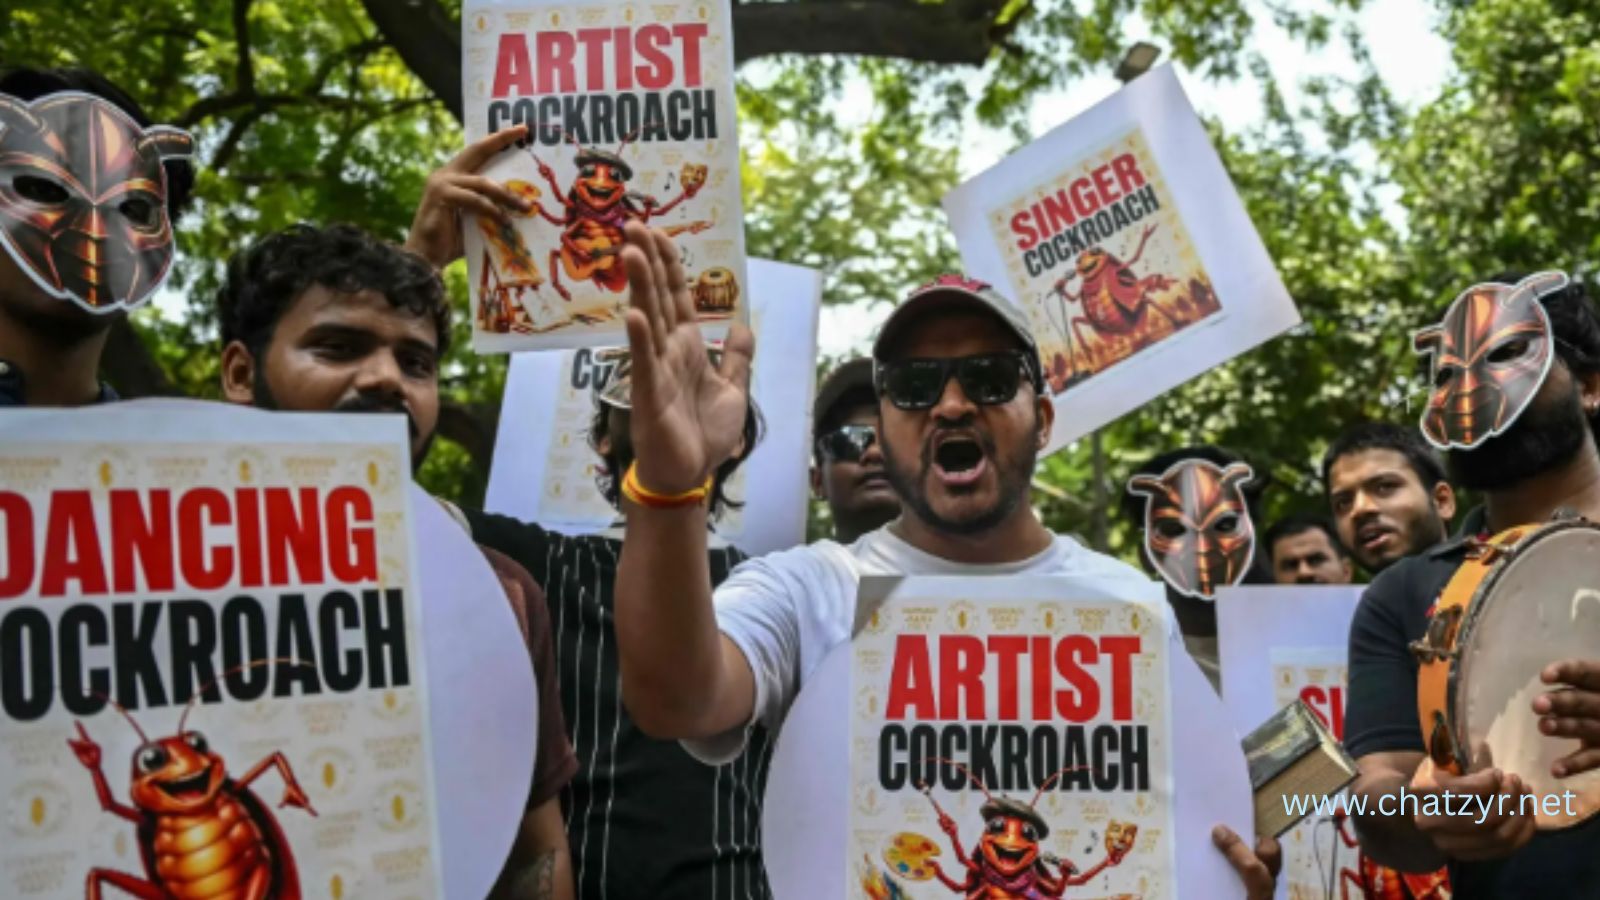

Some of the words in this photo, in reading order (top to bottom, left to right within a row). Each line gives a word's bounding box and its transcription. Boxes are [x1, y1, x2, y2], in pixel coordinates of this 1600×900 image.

[491, 23, 708, 98] ARTIST
[488, 89, 718, 148] COCKROACH
[1010, 153, 1146, 250] SINGER
[1023, 185, 1160, 278] COCKROACH
[0, 588, 410, 722] OCKROACH
[886, 634, 1142, 723] ARTIST
[878, 723, 1151, 792] COCKROACH
